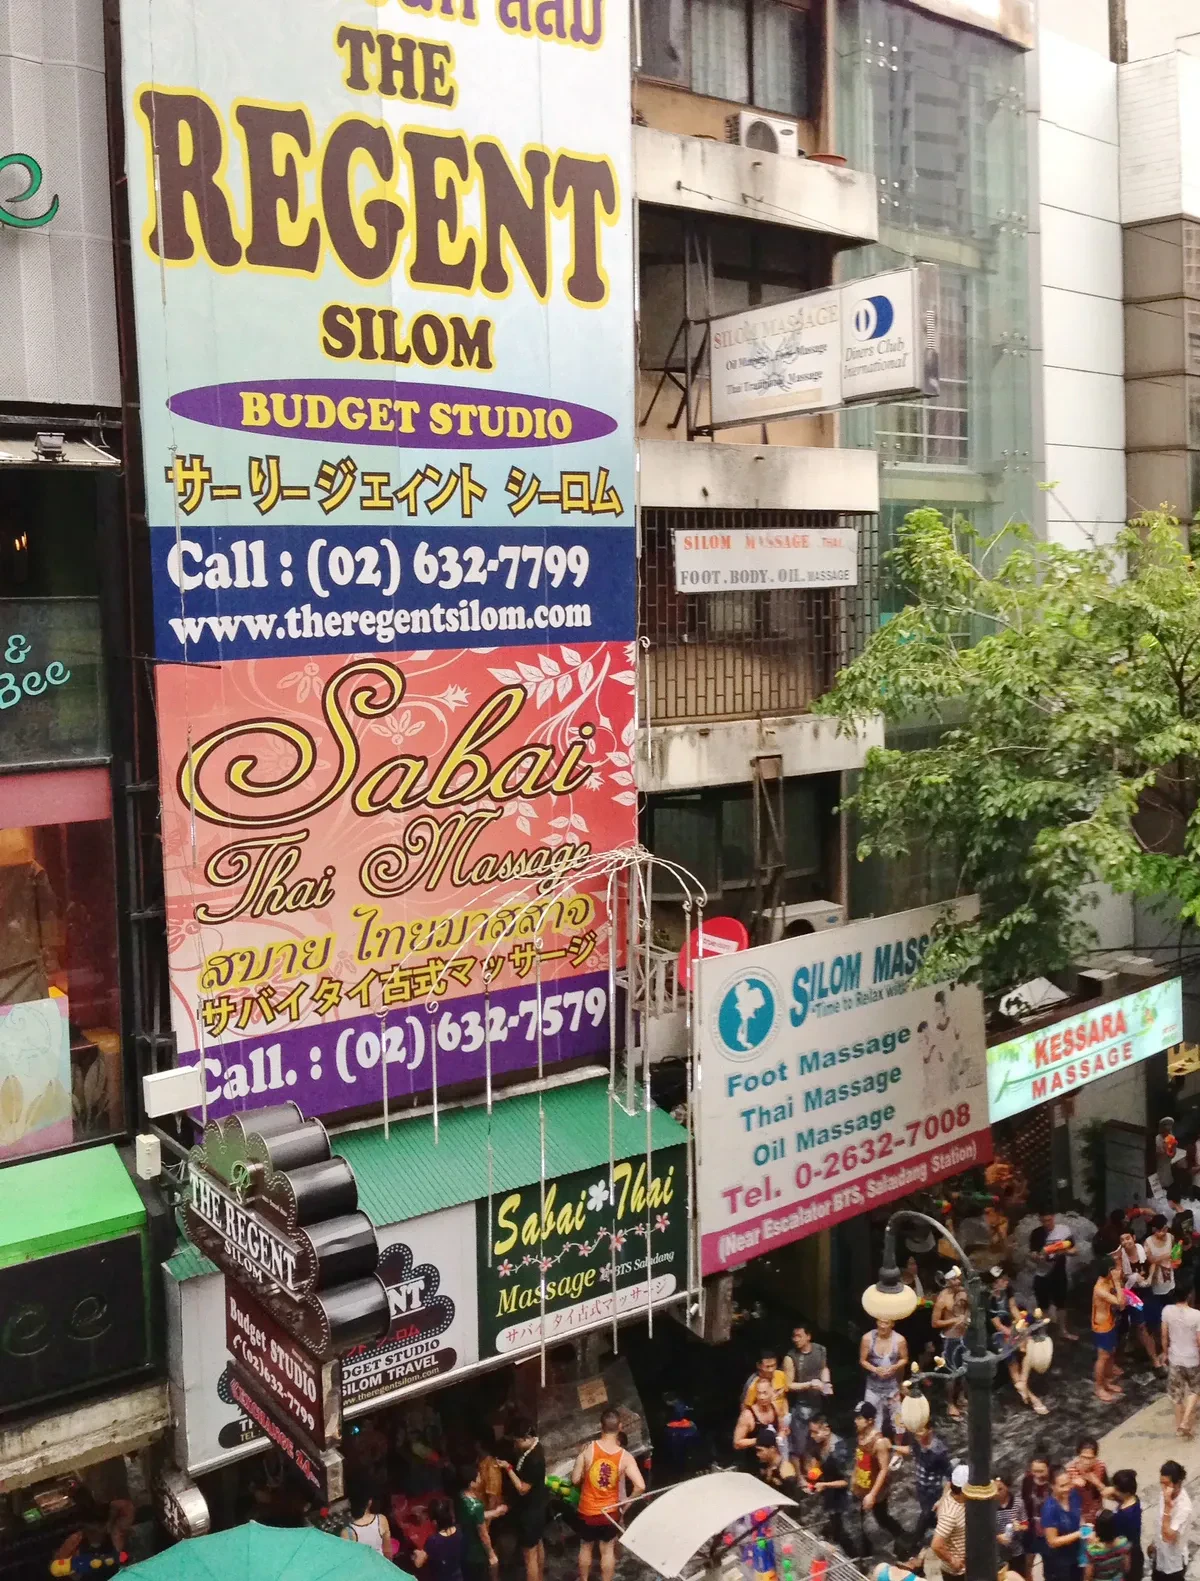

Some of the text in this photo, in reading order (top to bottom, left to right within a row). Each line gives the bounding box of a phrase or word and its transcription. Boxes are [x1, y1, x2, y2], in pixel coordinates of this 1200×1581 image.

[338, 26, 455, 106] THE
[139, 91, 617, 302] REGENT
[322, 306, 492, 370] SILOM
[877, 337, 905, 354] Club
[239, 391, 573, 440] BUDGET STUDIO
[504, 465, 624, 518] シーロム
[167, 540, 268, 590] Call
[307, 538, 402, 598] (02)
[413, 541, 590, 592] 632-7799
[683, 534, 732, 550] SILOM
[745, 534, 809, 549] MASSAGE
[168, 600, 593, 645] www.theregentsilom.com
[176, 658, 597, 830] Sabai
[196, 808, 593, 924] Thai Massage
[202, 933, 332, 993] สบาย
[790, 951, 862, 1028] SILOM
[336, 1016, 426, 1086] (02)
[437, 986, 607, 1053] 632-7579
[726, 1025, 911, 1098] Foot Massage
[1034, 1009, 1128, 1070] KESSARA
[740, 1065, 903, 1133] Thai Massage
[1031, 1040, 1133, 1100] MASSAGE
[722, 1102, 972, 1215] Tel. 0-2632-7008
[753, 1103, 897, 1167] Oil Massage
[189, 1171, 297, 1291] THE REGENT
[494, 1161, 675, 1256] Sabai Thai
[717, 1230, 760, 1263] (Near
[762, 1199, 831, 1239] Escalator
[931, 1139, 978, 1174] Station)
[224, 1239, 264, 1284] SILOM
[495, 1268, 597, 1319] Massage
[229, 1296, 267, 1352] Budget
[270, 1338, 317, 1403] STUDIO
[342, 1360, 381, 1380] DGET
[385, 1338, 440, 1367] STUDIO
[386, 1354, 439, 1380] TRAVEL
